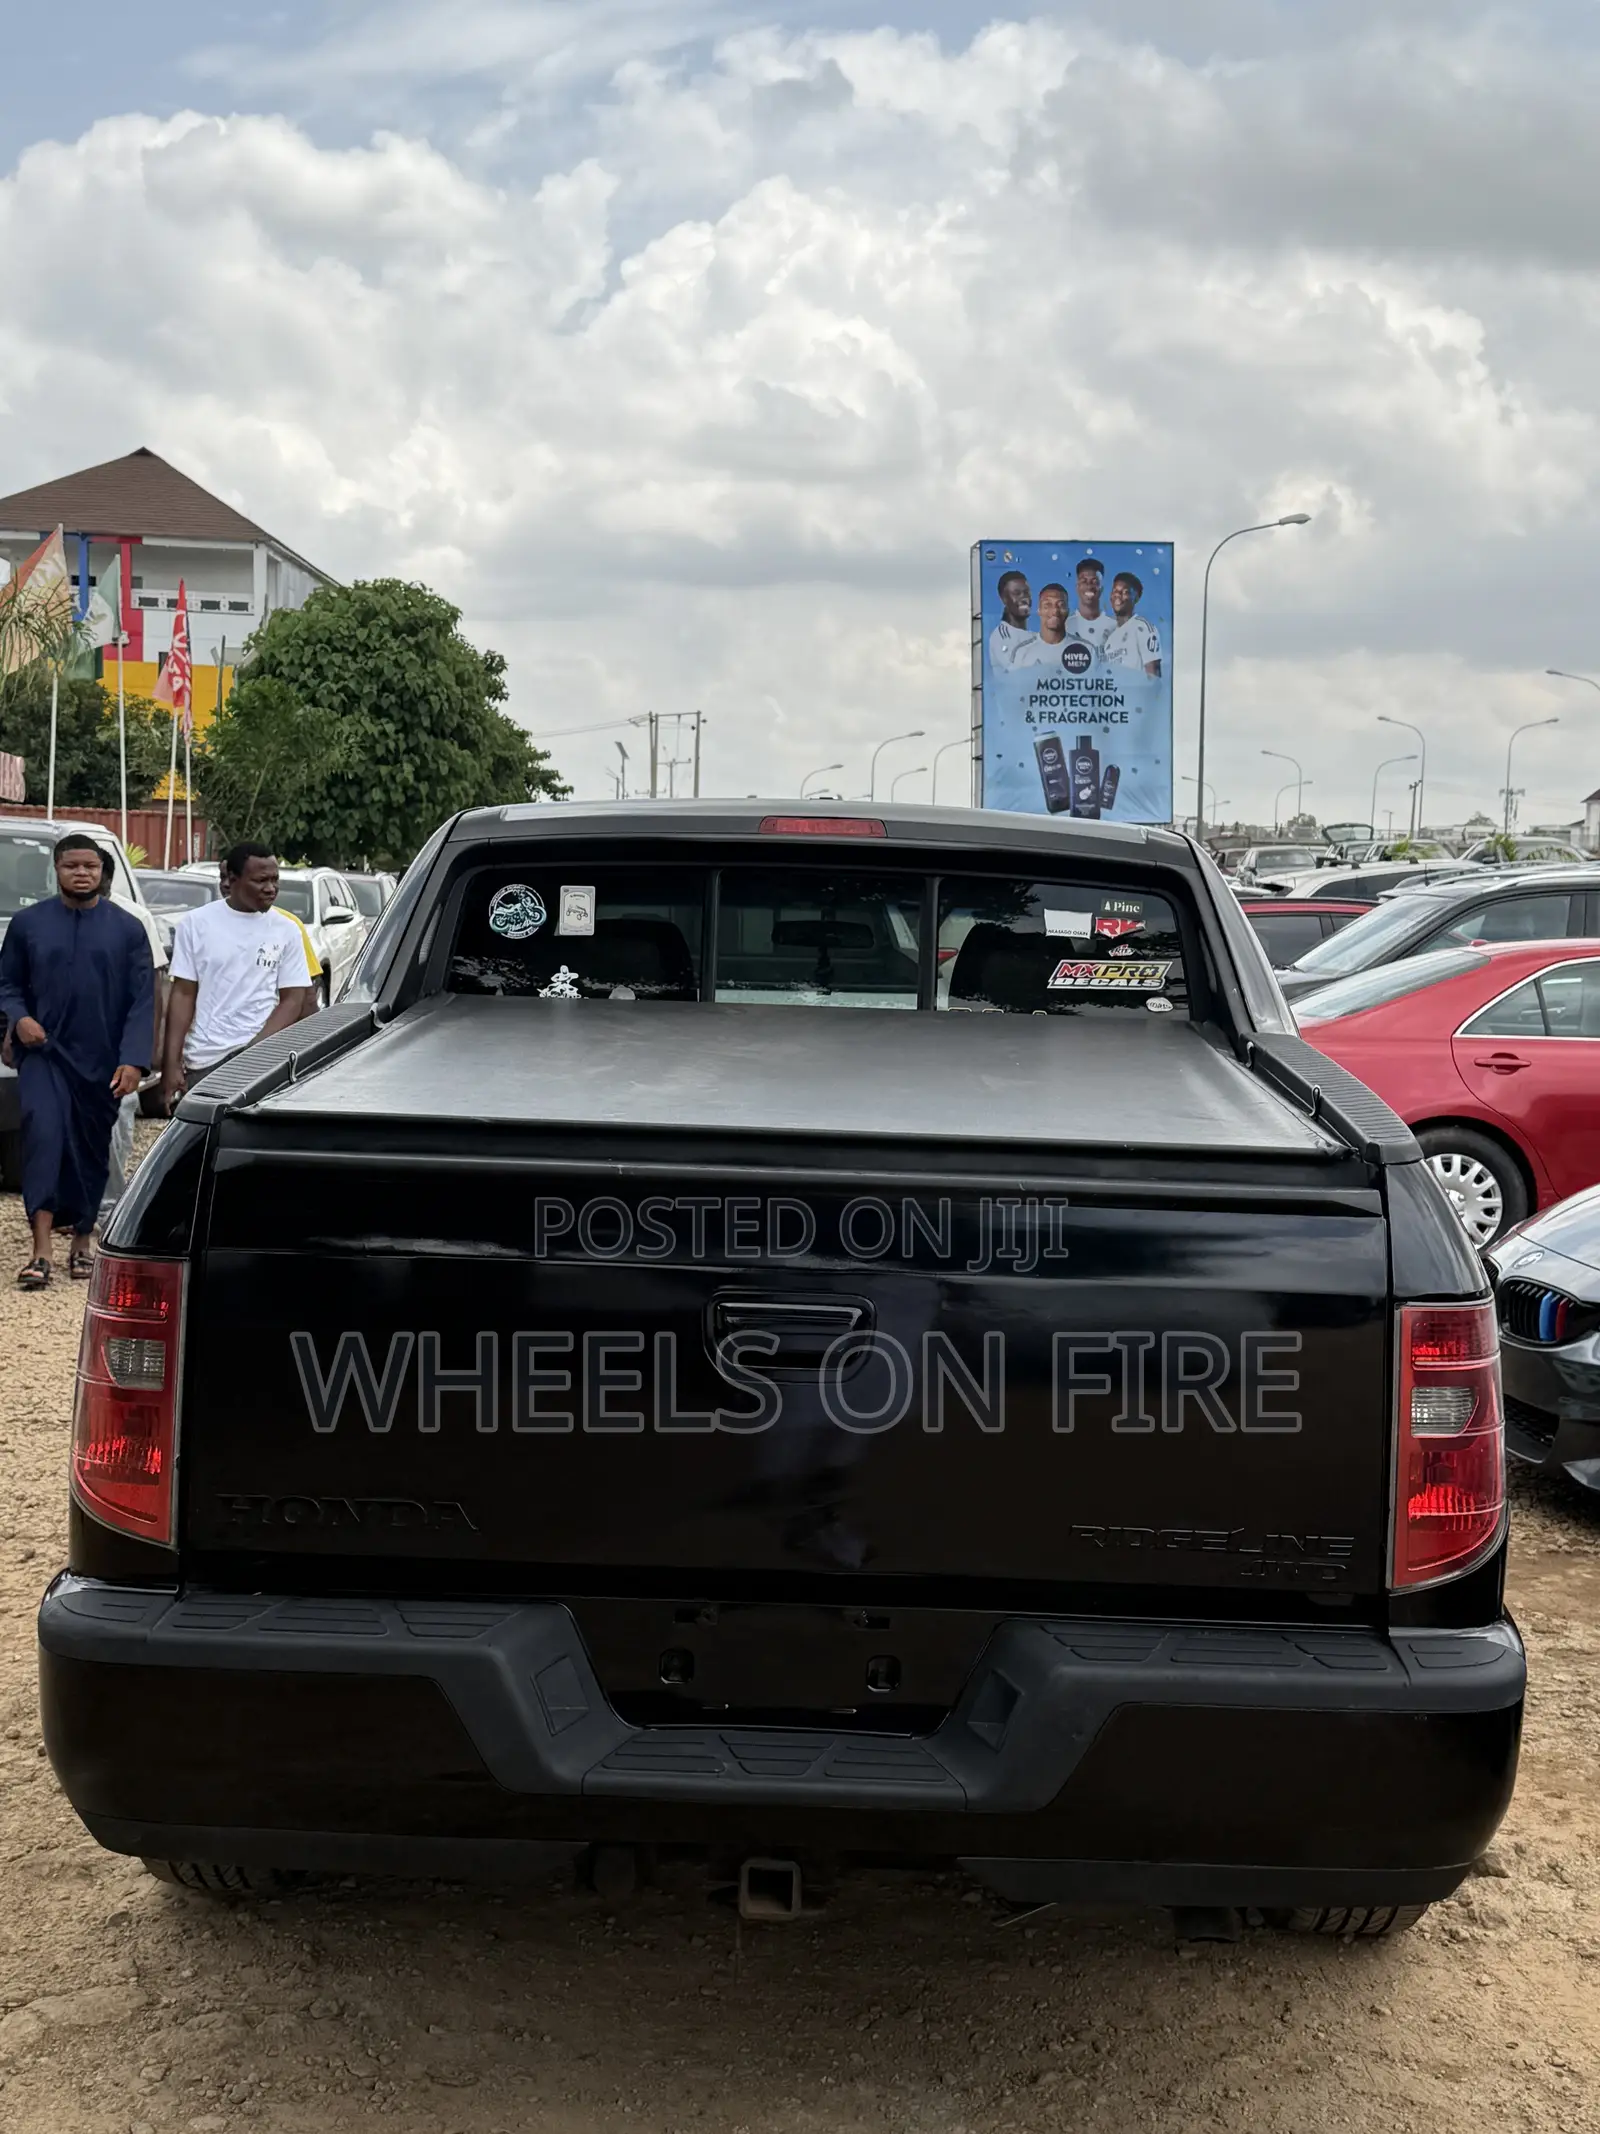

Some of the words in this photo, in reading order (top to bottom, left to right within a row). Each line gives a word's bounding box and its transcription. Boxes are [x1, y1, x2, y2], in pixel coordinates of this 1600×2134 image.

[1064, 653, 1090, 661] NIVEA
[1067, 660, 1086, 668] MEN
[1036, 678, 1118, 692] MOISTURE,
[1029, 694, 1125, 707] PROTECTION
[1025, 710, 1036, 724] &
[1038, 711, 1129, 724] FRAGRANCE
[1053, 977, 1162, 987] DECALS
[215, 1493, 481, 1534] HONDA
[1069, 1525, 1356, 1557] RIDGELINE
